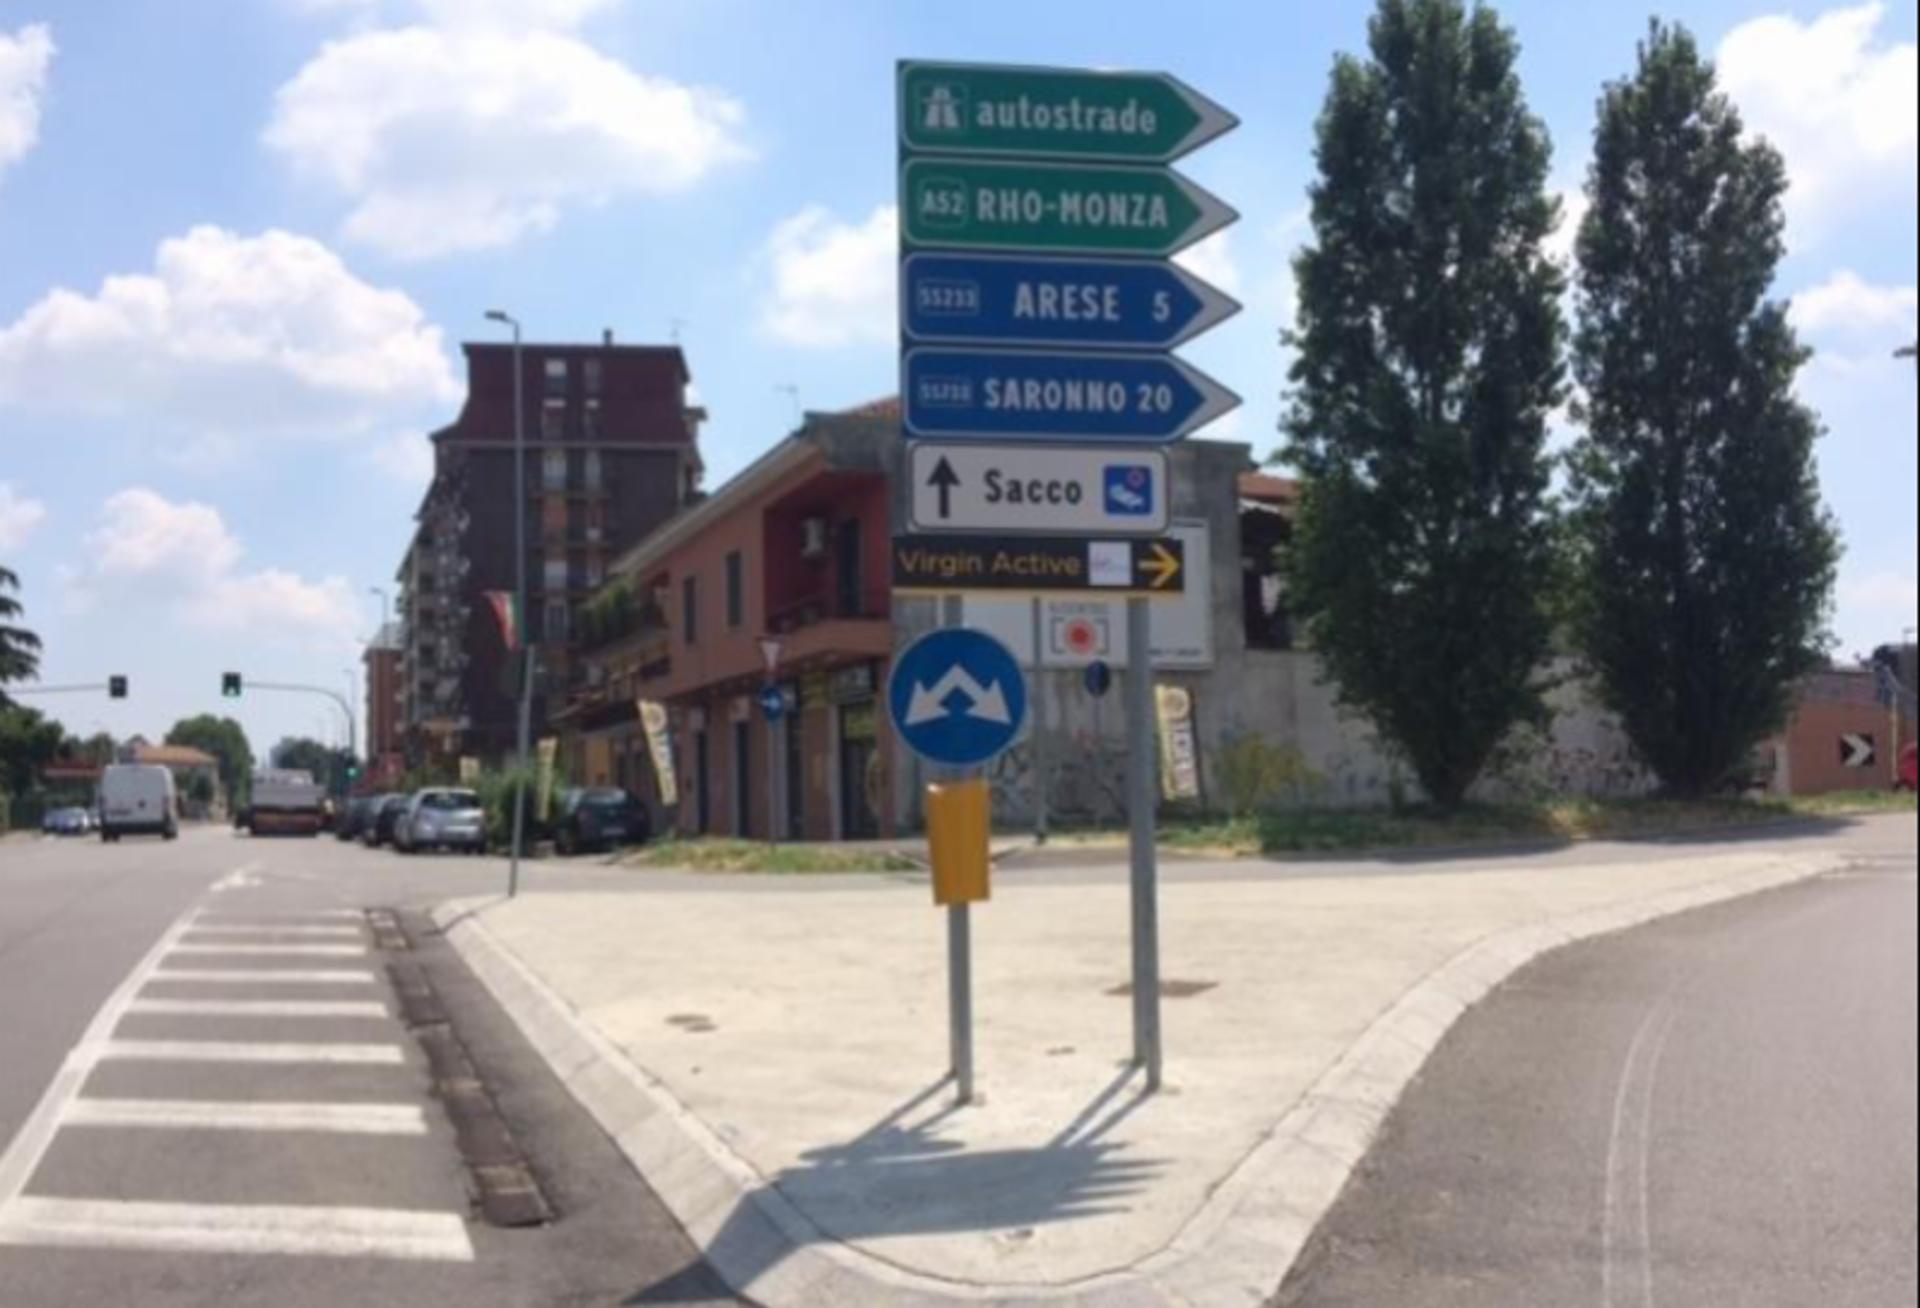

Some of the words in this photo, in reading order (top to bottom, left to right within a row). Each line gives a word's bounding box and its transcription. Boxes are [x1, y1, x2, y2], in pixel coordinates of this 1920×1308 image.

[976, 96, 1158, 135] autostrade
[922, 189, 965, 215] A52
[976, 189, 1169, 228] RHO-MONZA
[1014, 282, 1121, 321] ARESE
[1152, 290, 1171, 322] 5
[983, 377, 1127, 413] SARONNO
[1137, 385, 1173, 412] 20
[982, 468, 1082, 504] Sacco
[899, 551, 982, 577] Virgin
[990, 552, 1081, 576] Active
